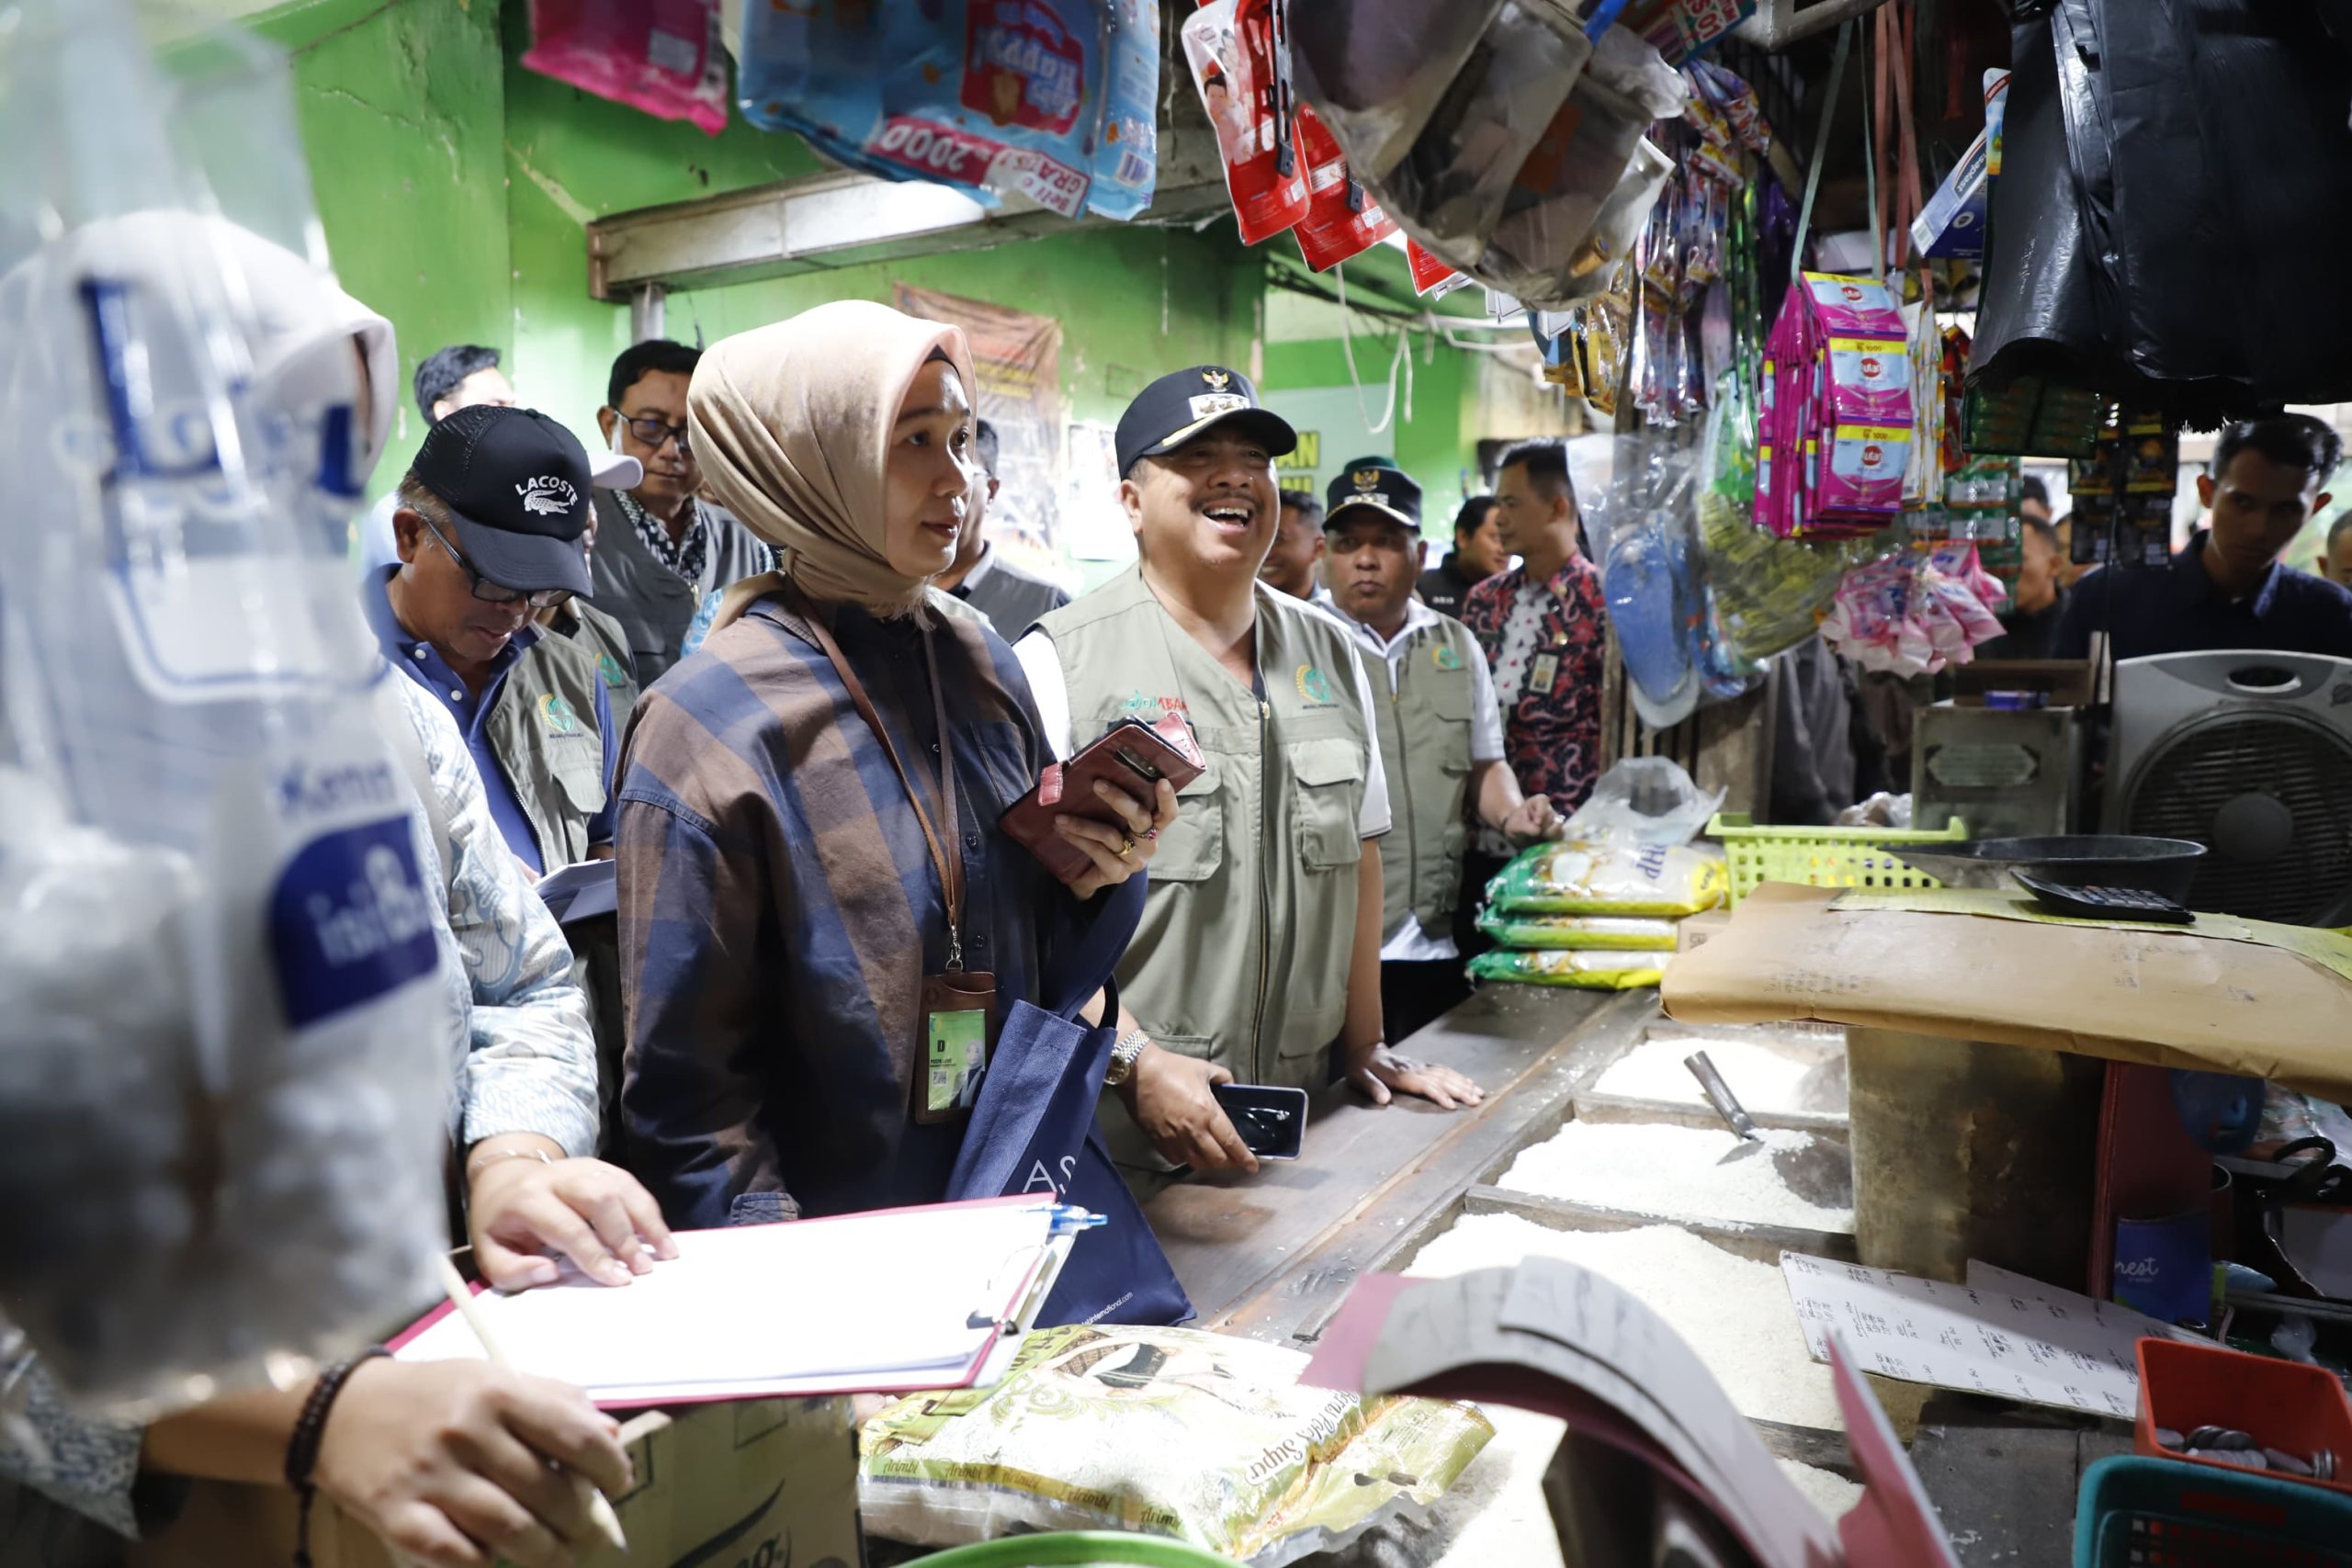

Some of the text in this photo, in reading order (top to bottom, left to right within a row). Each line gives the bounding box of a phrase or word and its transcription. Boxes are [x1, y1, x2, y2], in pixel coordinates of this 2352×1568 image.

[1957, 153, 1986, 193] saplast
[514, 475, 579, 506] LACOSTE
[883, 1460, 919, 1474] Arimbi
[1250, 1438, 1304, 1480] Super
